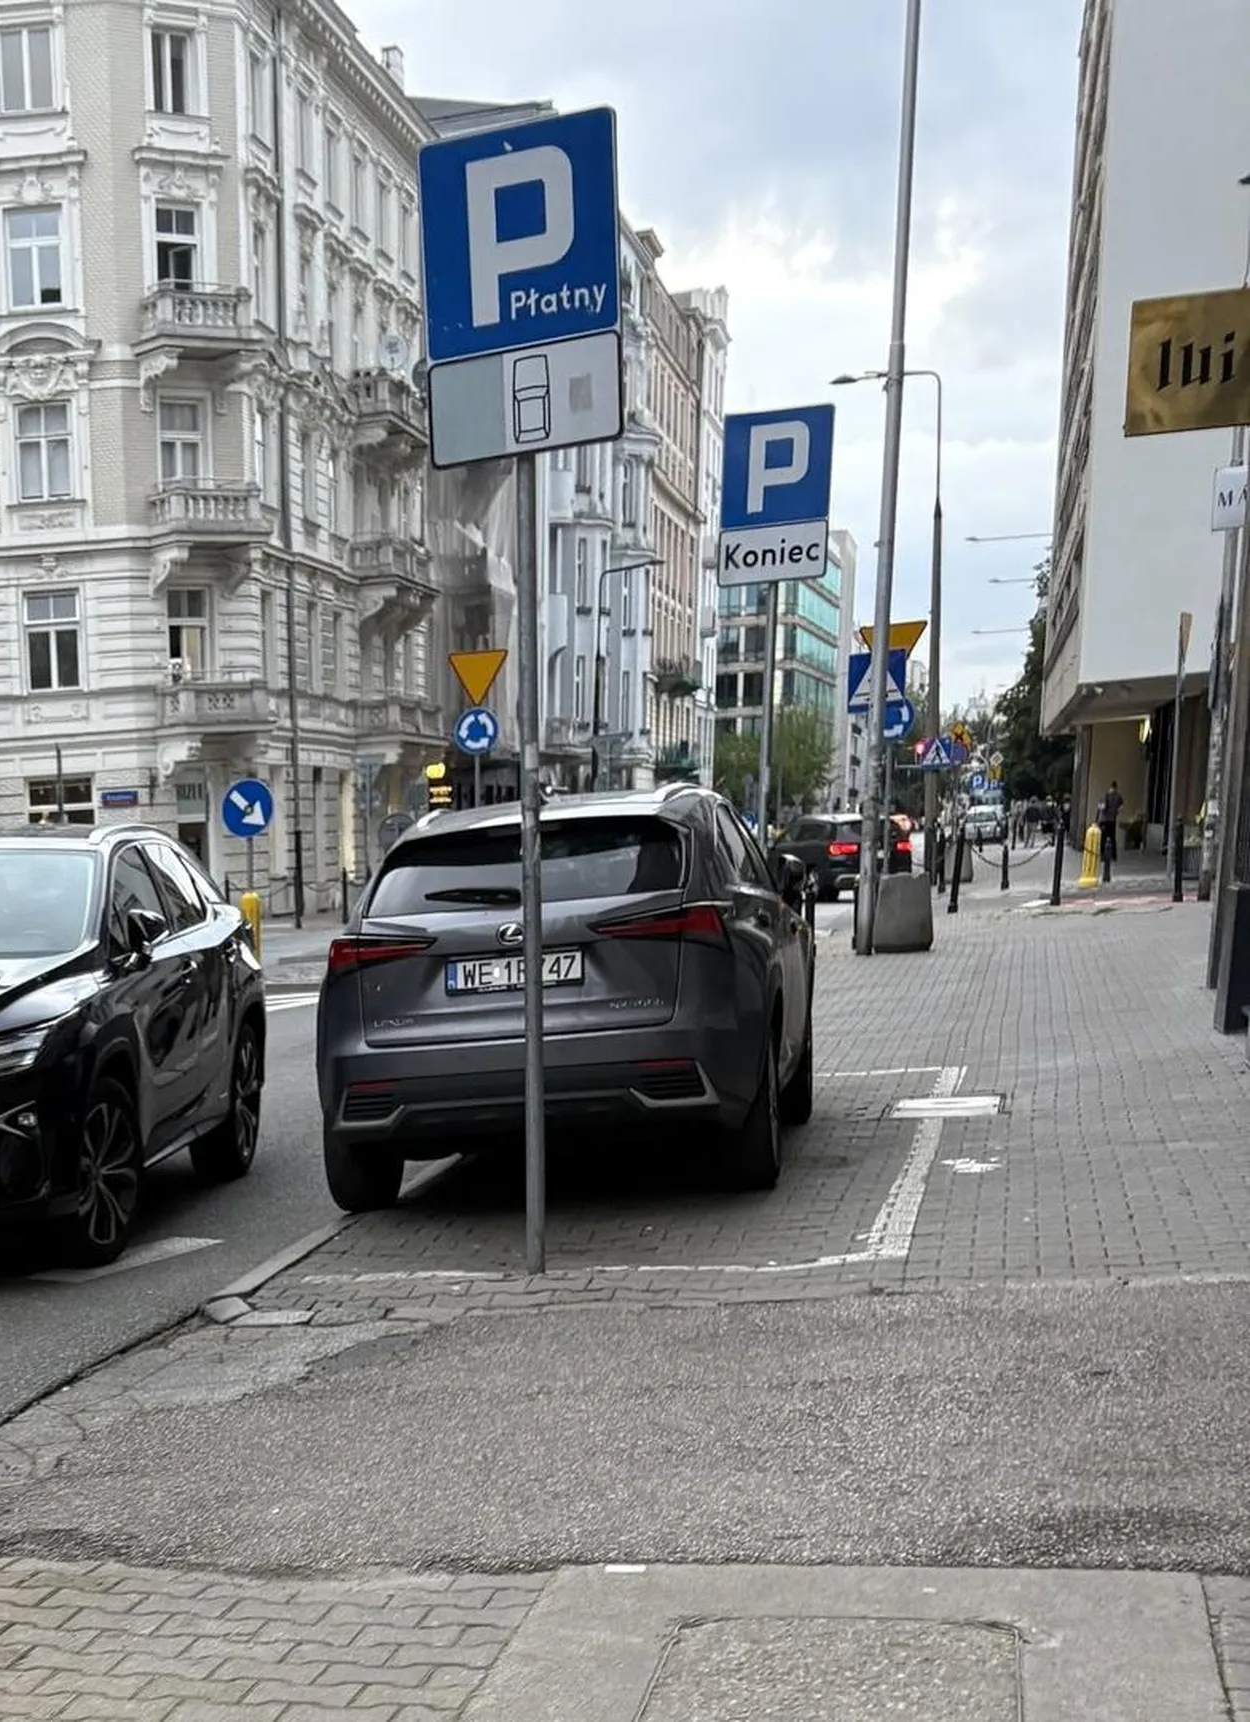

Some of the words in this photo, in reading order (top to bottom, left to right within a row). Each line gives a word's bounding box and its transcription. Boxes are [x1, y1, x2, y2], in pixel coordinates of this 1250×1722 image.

[465, 144, 575, 328] P
[510, 283, 607, 320] Płatny
[1155, 331, 1237, 392] lui
[747, 421, 811, 515] P
[724, 538, 820, 571] Koniec
[462, 962, 493, 987] WE
